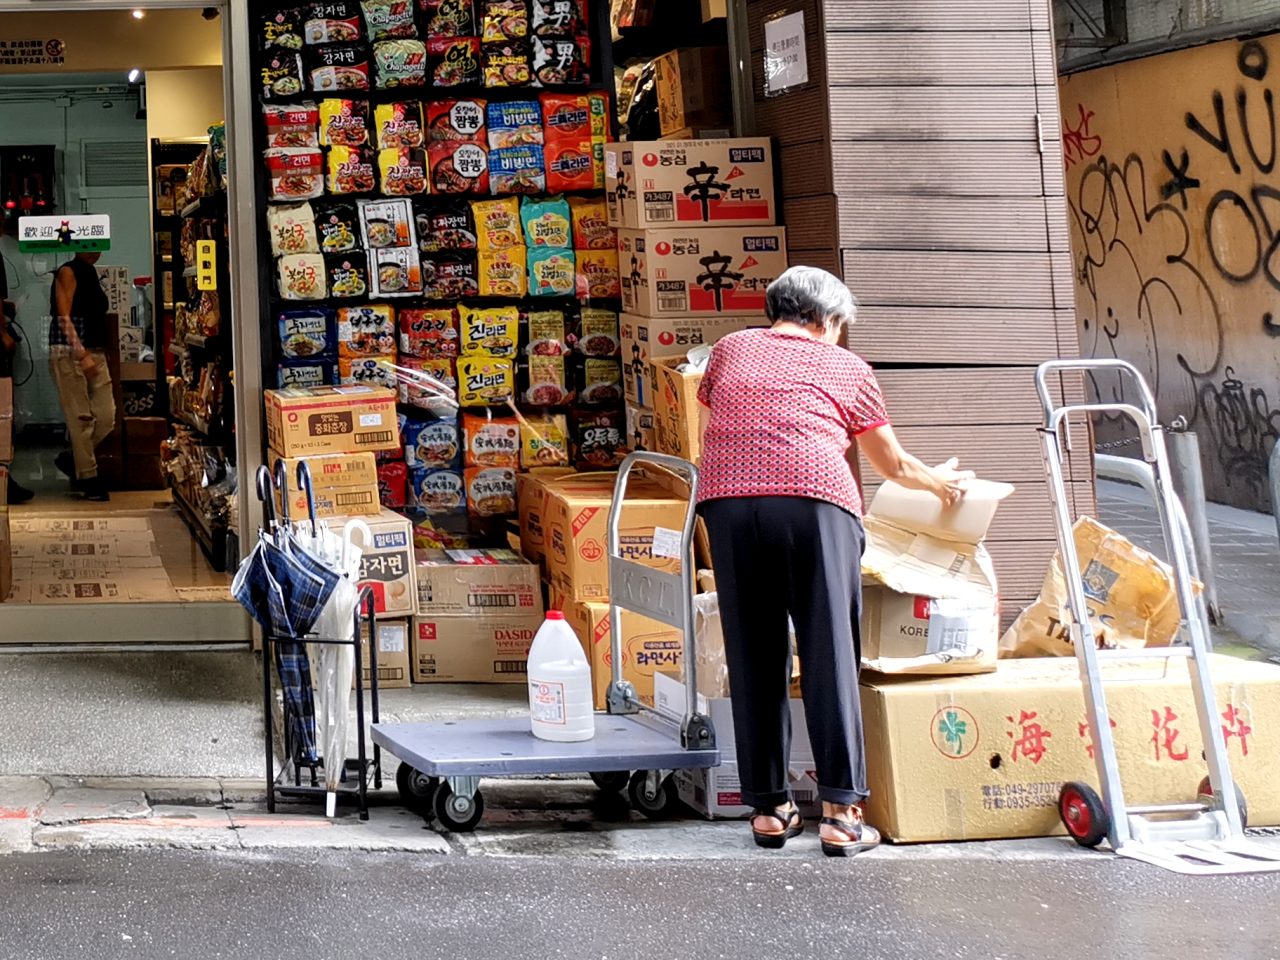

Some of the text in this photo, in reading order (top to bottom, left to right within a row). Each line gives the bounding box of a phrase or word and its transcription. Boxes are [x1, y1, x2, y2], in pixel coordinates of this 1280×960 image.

[323, 51, 355, 65] 감자면
[454, 115, 480, 129] 짬뽕
[659, 155, 687, 166] 농심
[731, 149, 762, 161] 멀티팩
[458, 159, 482, 172] 짬뽕
[683, 161, 731, 222] 辛
[730, 188, 761, 201] 라면
[24, 225, 104, 237] 歡迎 光臨
[672, 244, 700, 255] 농심
[745, 238, 776, 249] 멀티팩
[696, 250, 744, 312] 辛
[350, 314, 385, 328] 너구리
[411, 320, 446, 333] 너구리
[468, 323, 507, 341] 진라면
[676, 333, 704, 345] 농심
[466, 373, 505, 391] 진라면
[376, 533, 406, 547] 멀티팩
[494, 630, 536, 641] DASID
[636, 651, 682, 666] 라면사
[1006, 704, 1252, 764] 海花卉
